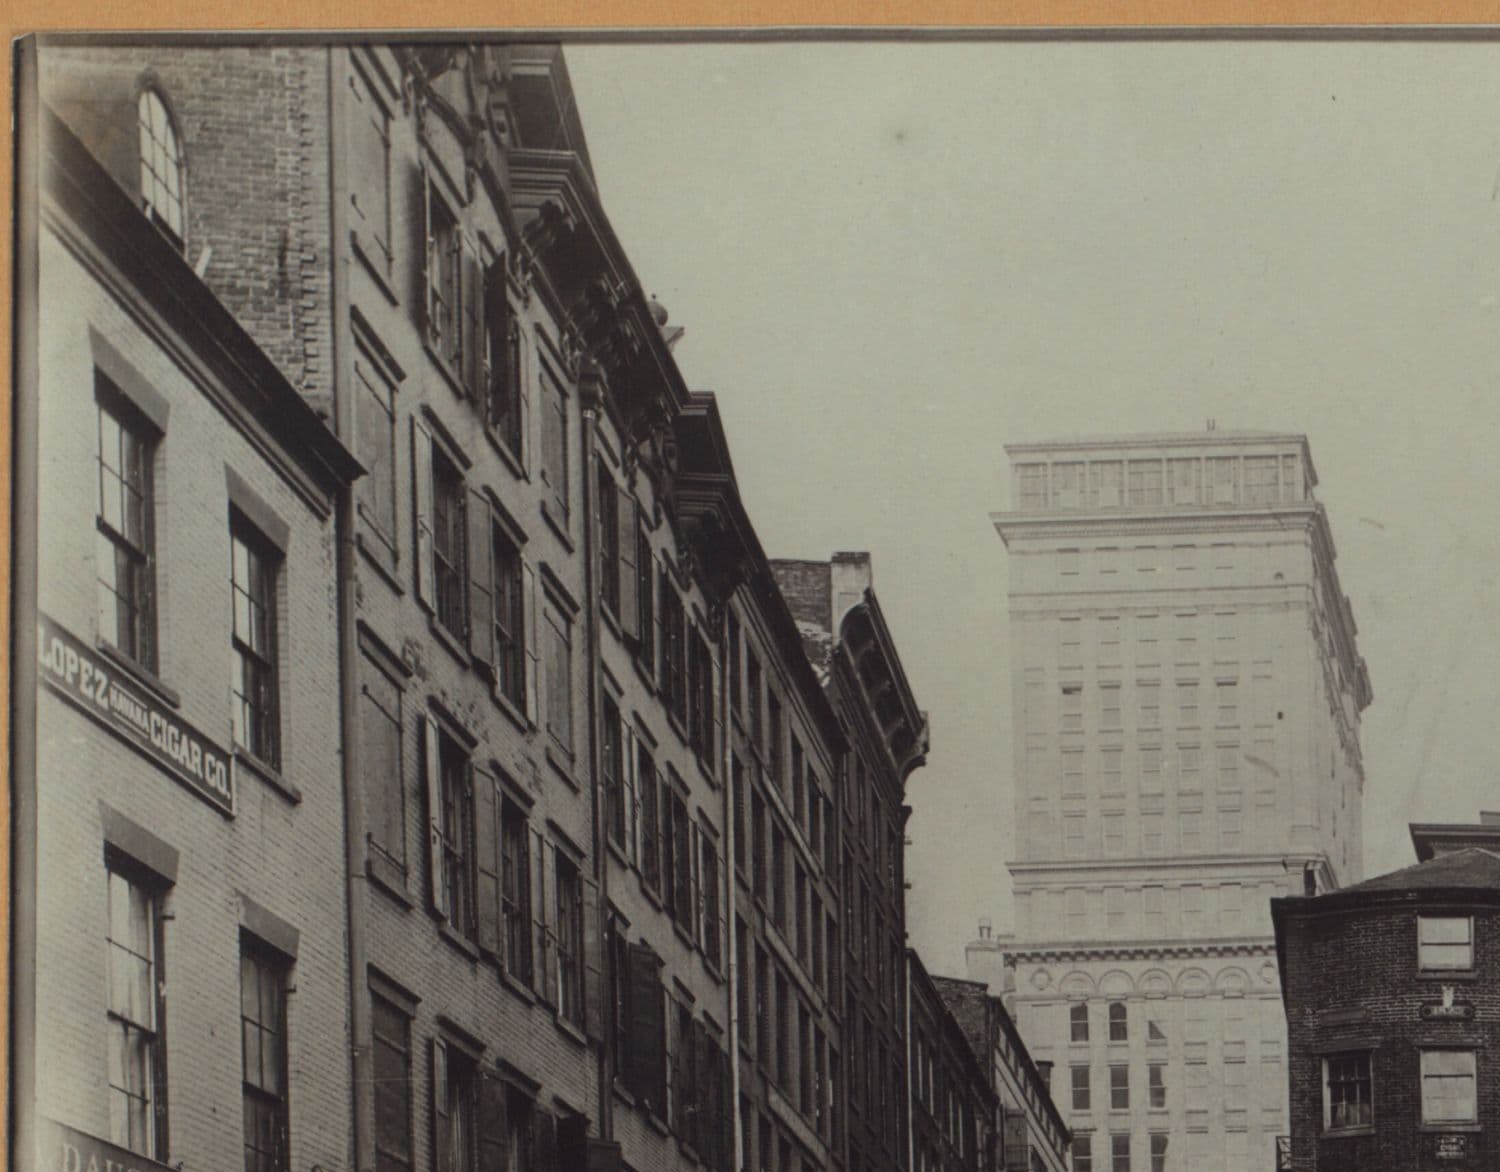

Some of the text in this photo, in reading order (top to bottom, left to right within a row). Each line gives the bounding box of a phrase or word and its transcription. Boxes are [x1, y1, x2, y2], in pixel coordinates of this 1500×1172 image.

[38, 625, 231, 799] LOPEZ HAVANA CIGAR CO.
